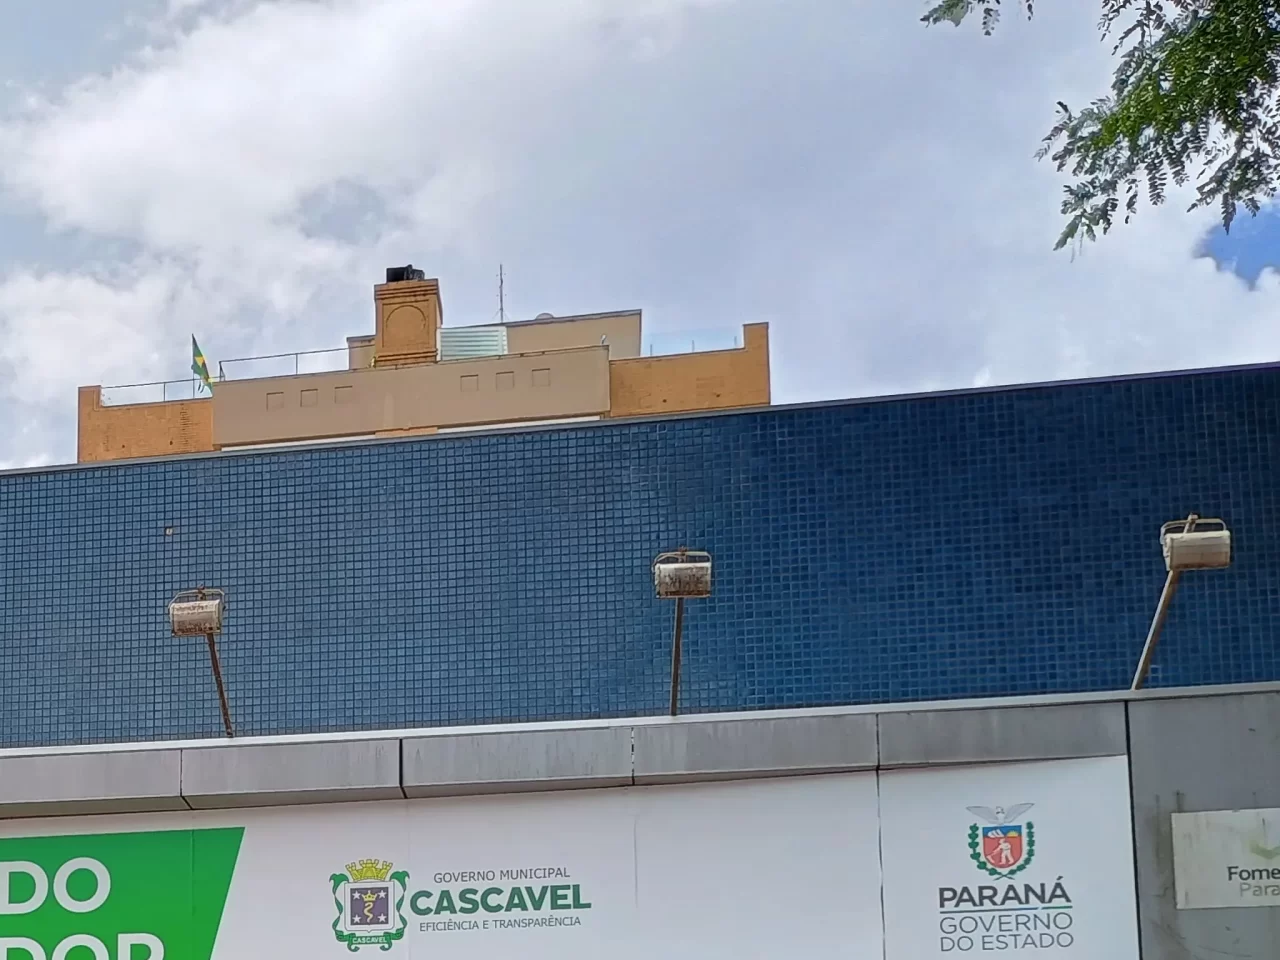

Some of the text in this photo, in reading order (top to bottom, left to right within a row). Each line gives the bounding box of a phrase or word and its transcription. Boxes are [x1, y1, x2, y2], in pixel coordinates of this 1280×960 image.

[433, 867, 571, 884] GOVERNO MUNICIPAL
[409, 884, 592, 916] CASCAVEL
[938, 875, 1072, 909] PARANÁ
[419, 914, 582, 932] EFICIÊNCIA E TRANSPARÊNCIA
[939, 911, 1073, 935] GOVERNO
[939, 931, 1075, 952] DO ESTADO
